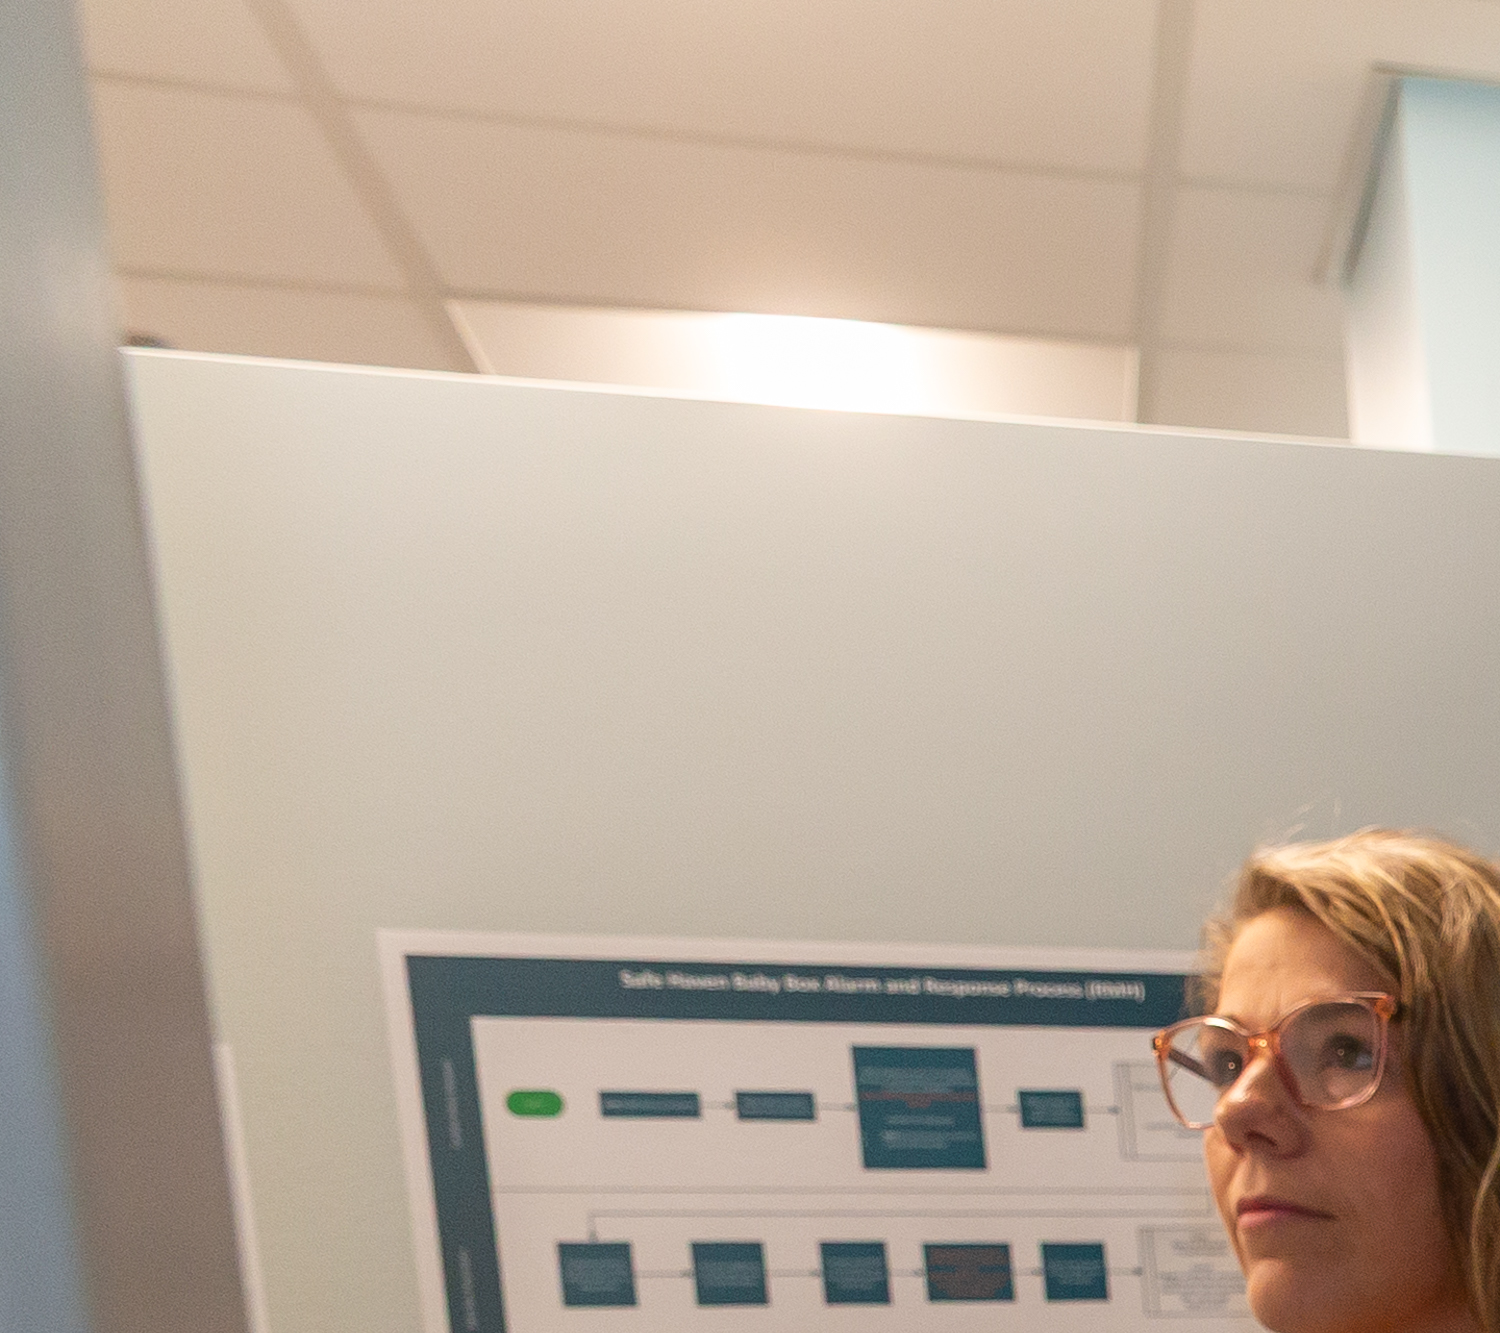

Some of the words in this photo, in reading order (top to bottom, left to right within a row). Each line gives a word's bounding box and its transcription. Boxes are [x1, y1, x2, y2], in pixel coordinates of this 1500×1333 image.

[619, 969, 664, 990] Safe
[666, 971, 729, 992] Haven
[731, 972, 780, 995] Baby
[783, 973, 821, 993] Box
[824, 974, 880, 994] Alarm
[884, 978, 921, 995] and
[923, 977, 1011, 998] Response
[1013, 978, 1083, 999] Process
